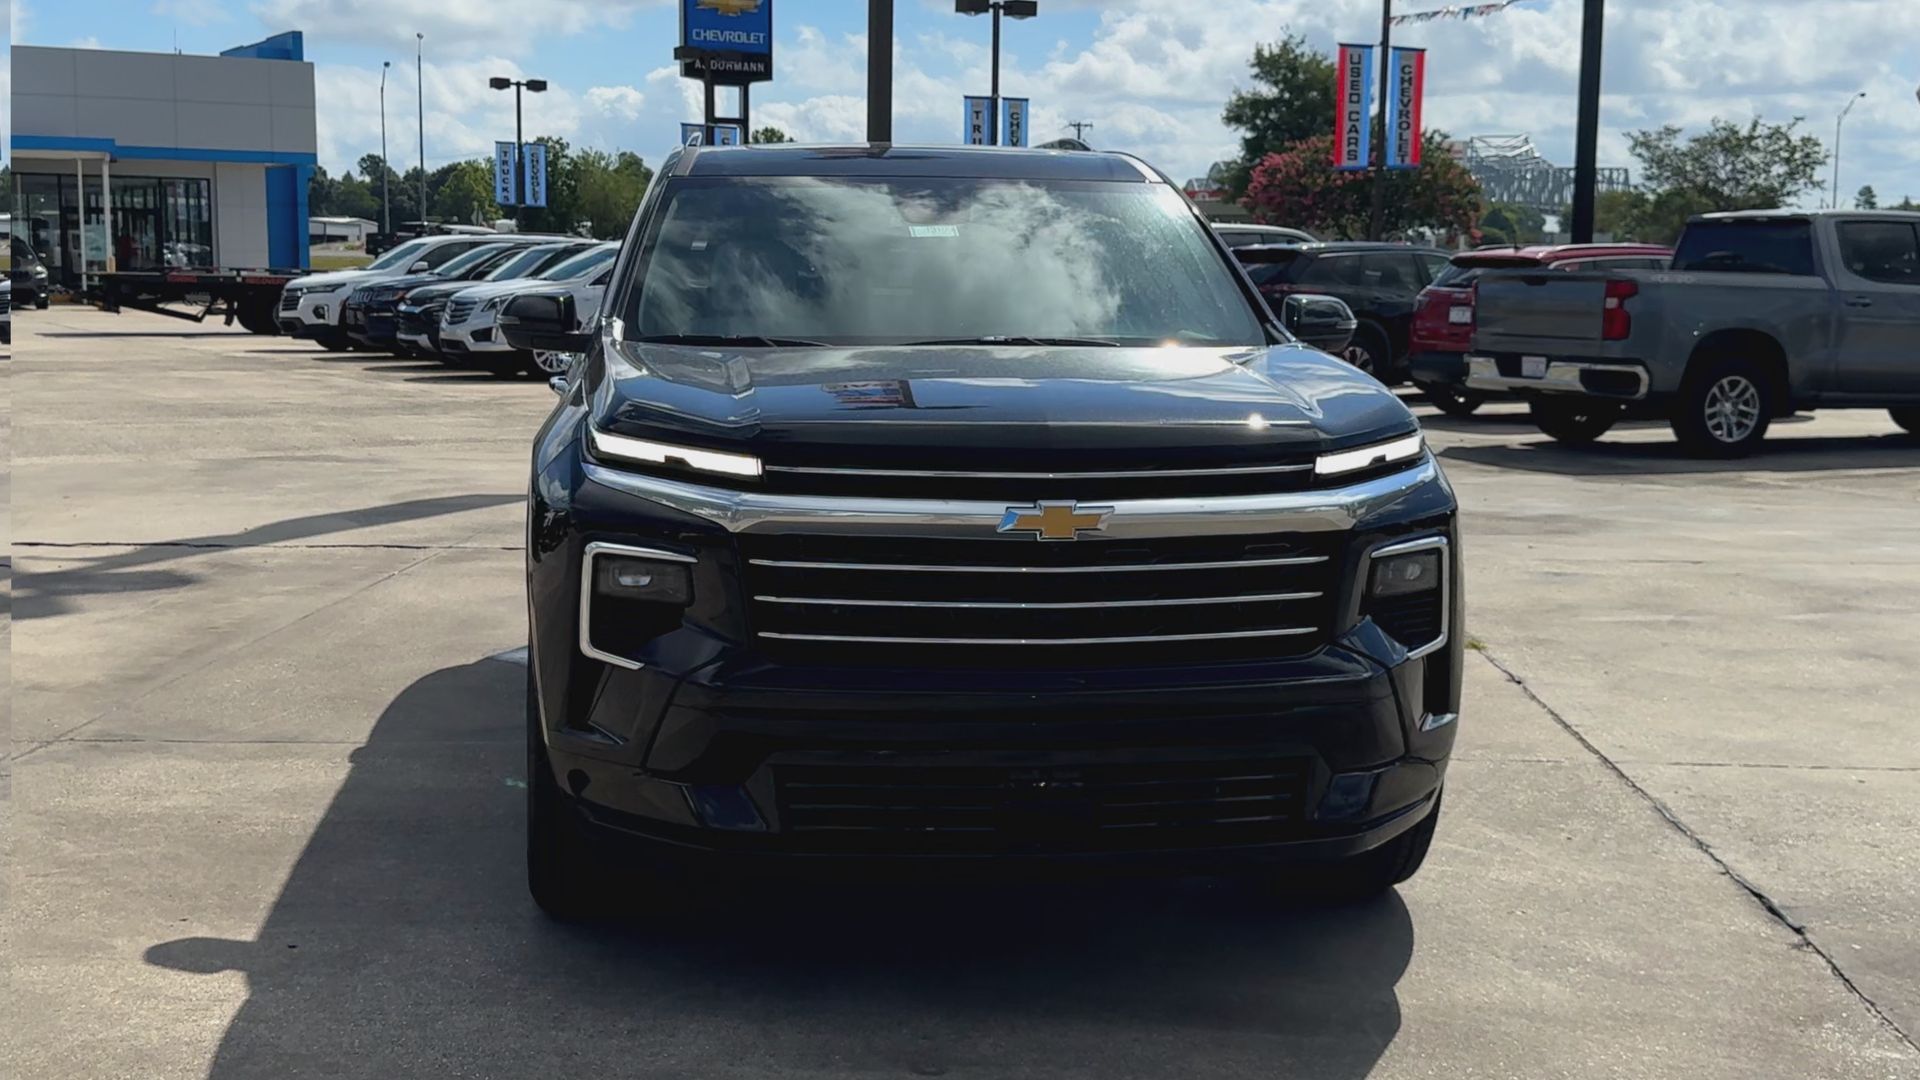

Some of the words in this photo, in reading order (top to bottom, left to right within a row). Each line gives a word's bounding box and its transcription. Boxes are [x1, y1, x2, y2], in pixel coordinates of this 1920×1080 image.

[692, 28, 766, 44] CHEVROLET
[1349, 53, 1361, 104] USED
[1347, 111, 1360, 162] CARS
[1398, 64, 1412, 164] CHEVROLET
[502, 150, 510, 202] TRUCKS
